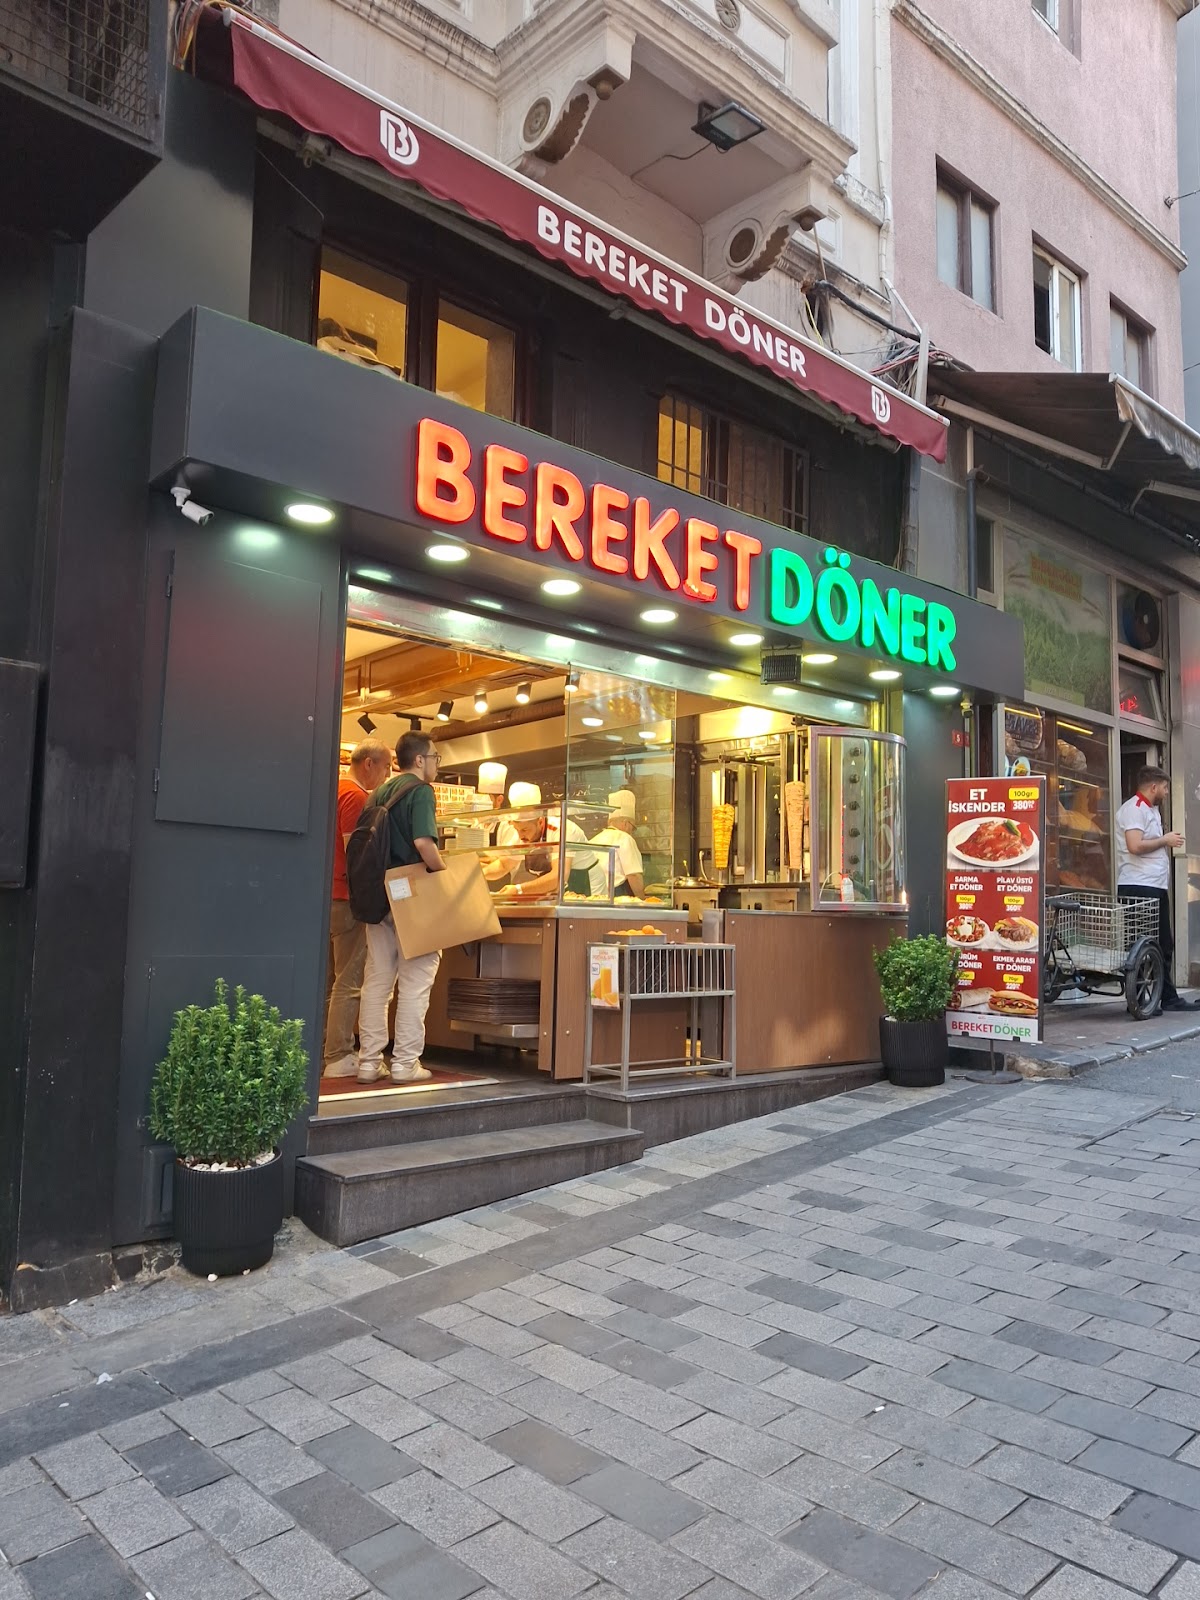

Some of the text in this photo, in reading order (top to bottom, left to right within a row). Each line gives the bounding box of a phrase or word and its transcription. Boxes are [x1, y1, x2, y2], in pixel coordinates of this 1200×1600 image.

[537, 205, 807, 378] BEREKET DÖNER
[415, 417, 957, 672] BEREKET DÖNER
[969, 788, 988, 801] ET
[948, 800, 1006, 813] İSKENDER
[1012, 800, 1028, 810] 380
[996, 876, 1034, 885] PİLAV ÜSTÜ
[949, 882, 984, 891] ET DÖNER
[996, 883, 1033, 893] ET DÖNER
[958, 960, 983, 969] DÖNER
[992, 955, 1036, 965] EKMEK ARASI
[996, 962, 1032, 973] ET DÖNER
[951, 1020, 1031, 1037] BEREKET DÖNER
